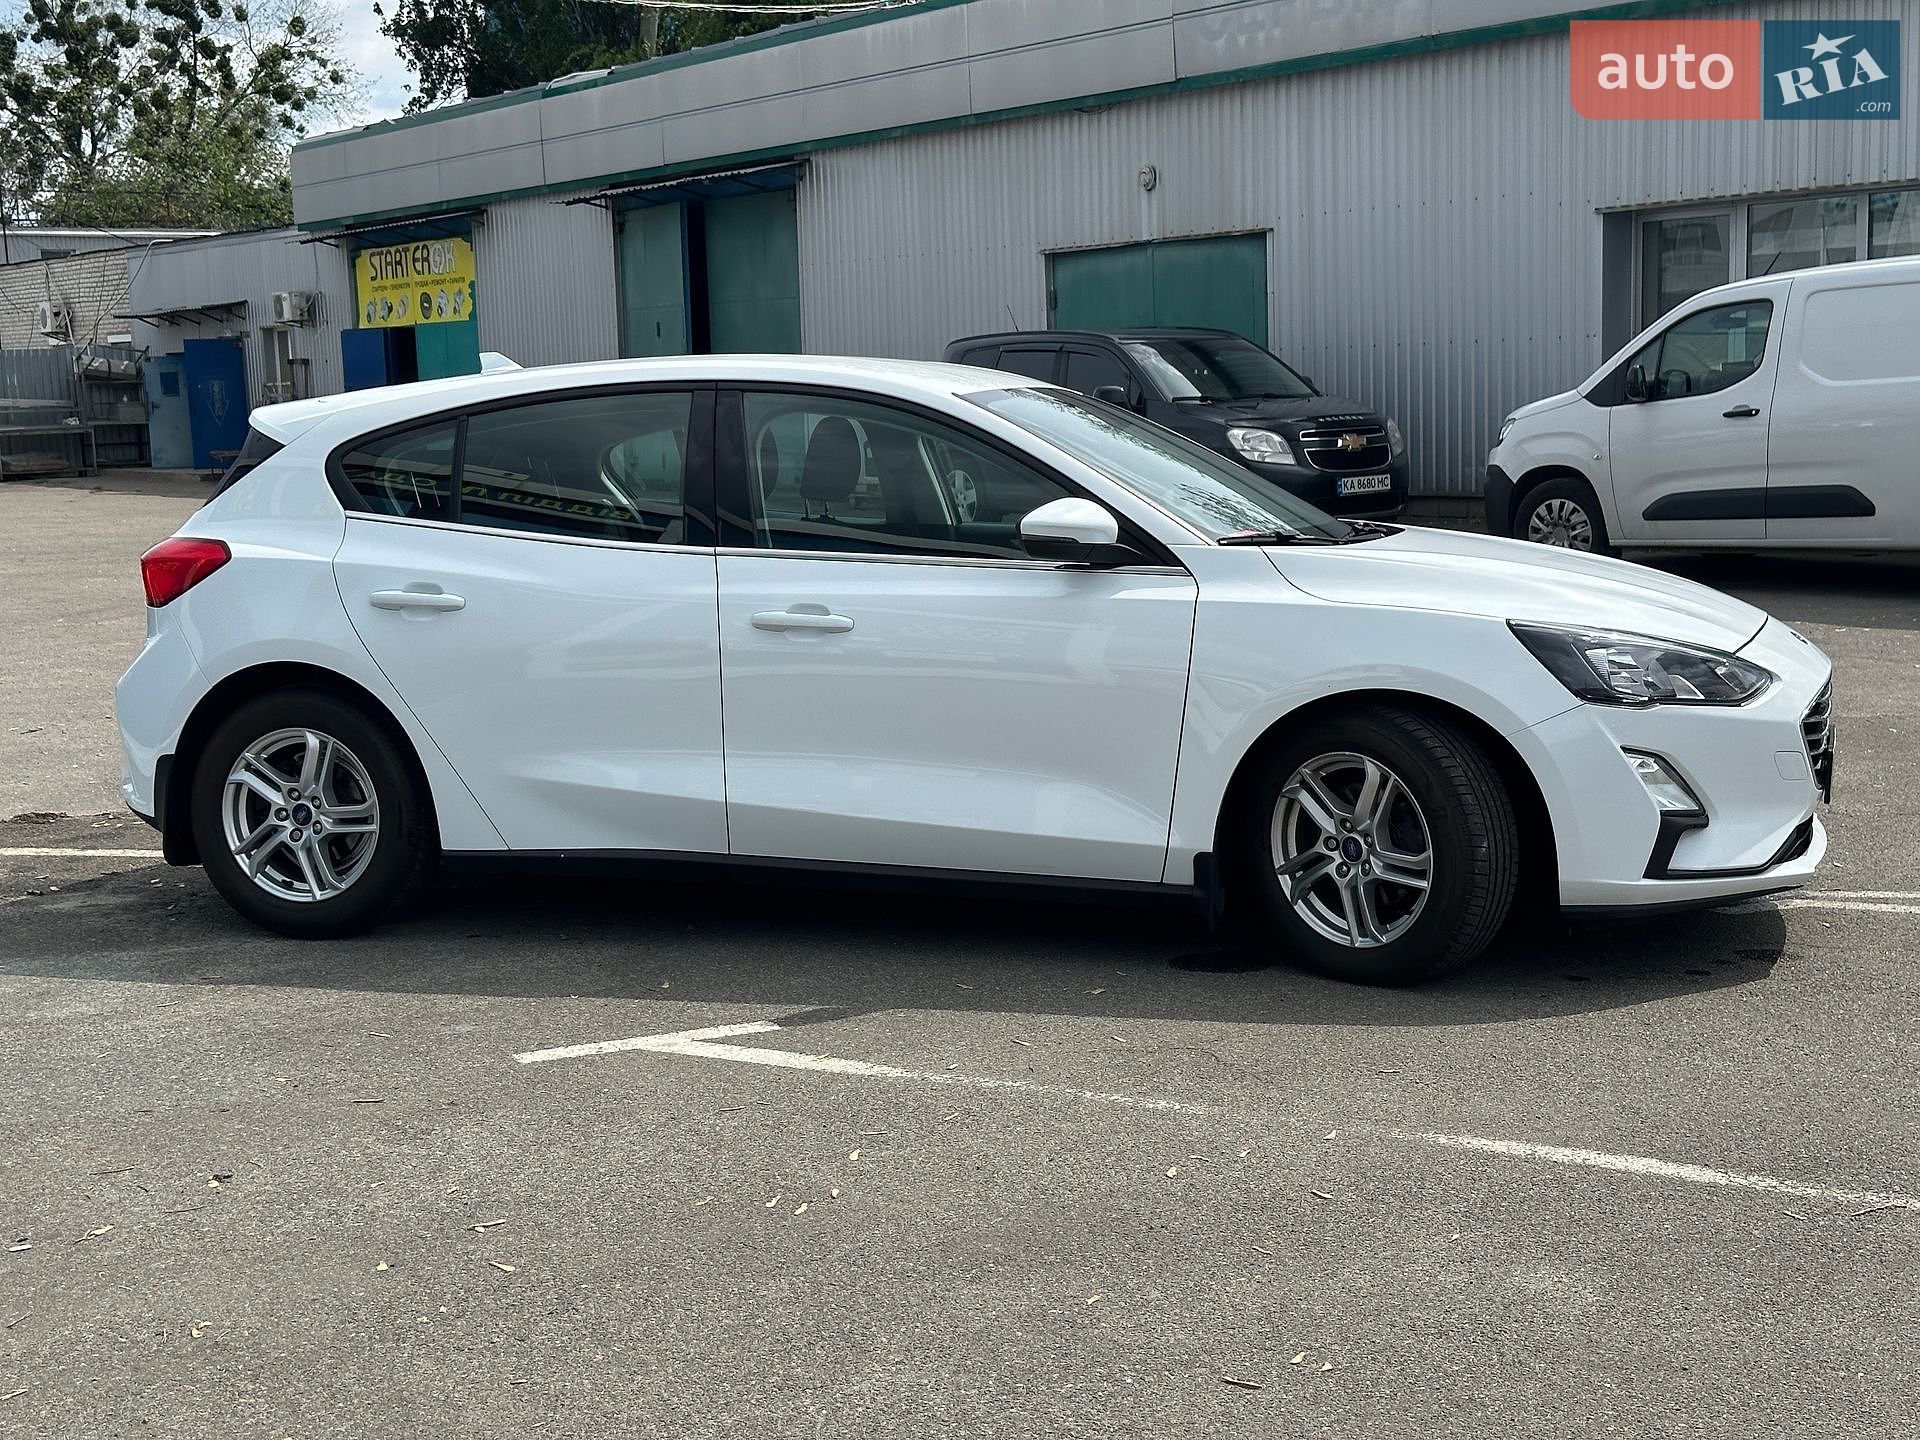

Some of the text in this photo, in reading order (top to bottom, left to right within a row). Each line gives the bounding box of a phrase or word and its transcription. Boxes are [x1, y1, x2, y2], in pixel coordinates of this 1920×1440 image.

[1343, 479, 1356, 492] KA
[1357, 477, 1376, 490] 8680
[1377, 476, 1389, 488] MC
